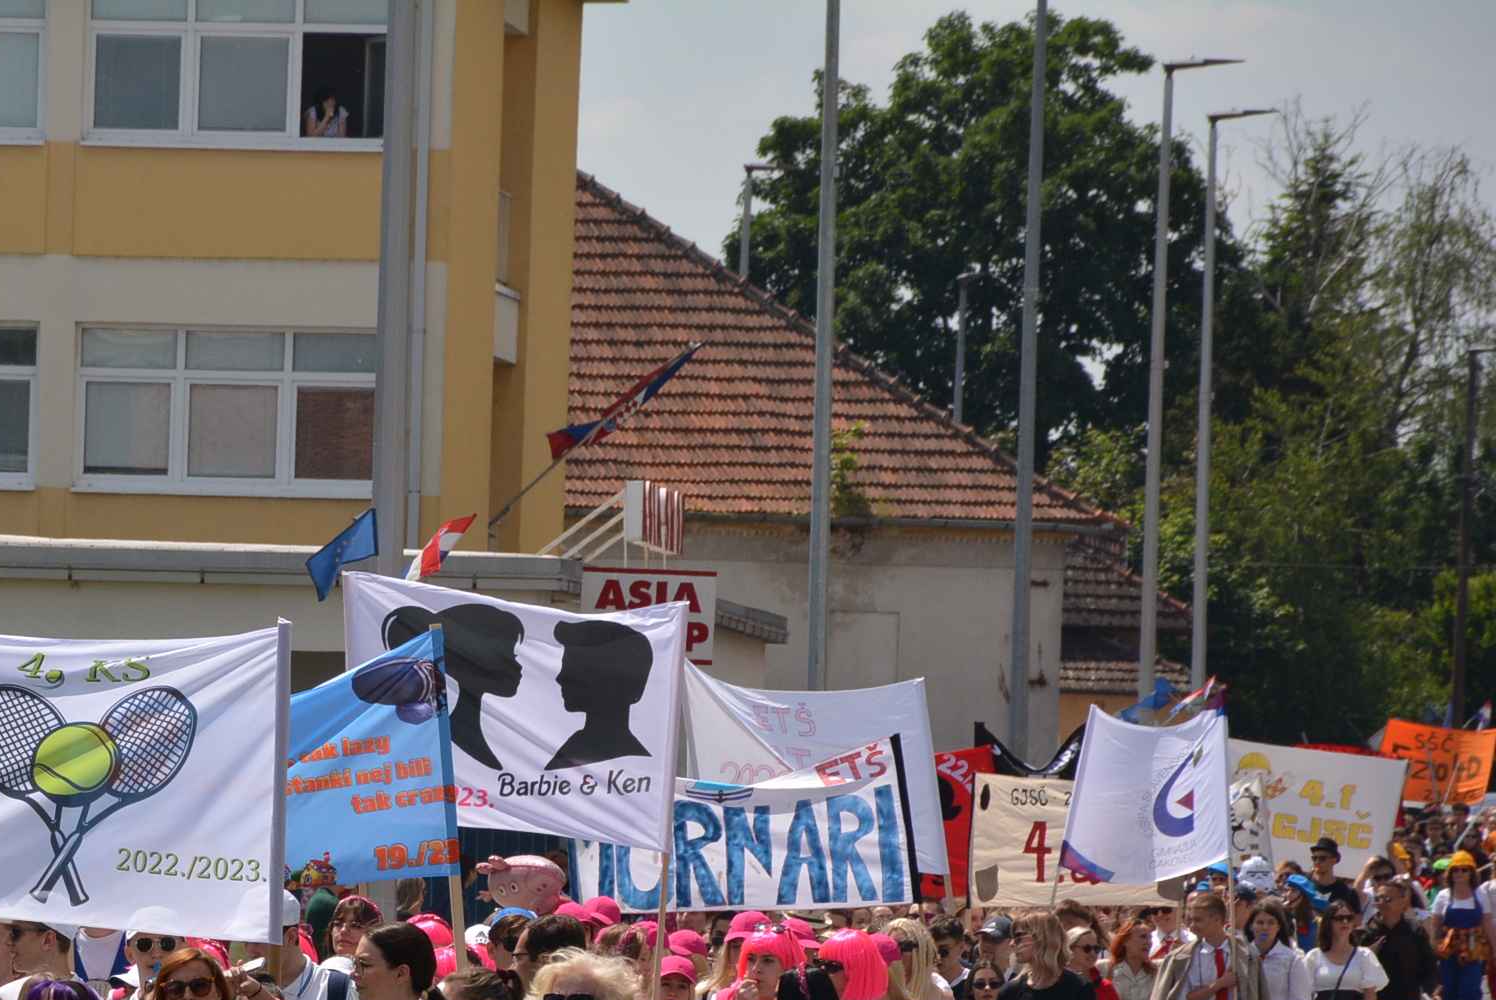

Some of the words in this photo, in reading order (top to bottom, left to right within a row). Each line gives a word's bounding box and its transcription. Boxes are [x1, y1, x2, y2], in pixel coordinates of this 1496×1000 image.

[595, 579, 701, 613] ASIA
[85, 656, 151, 682] KS
[815, 743, 888, 787] ETŠ
[498, 773, 572, 797] Barbie
[580, 774, 598, 796] &
[606, 769, 651, 796] Ken
[351, 792, 392, 815] tak
[115, 848, 267, 882] 2022./2023.
